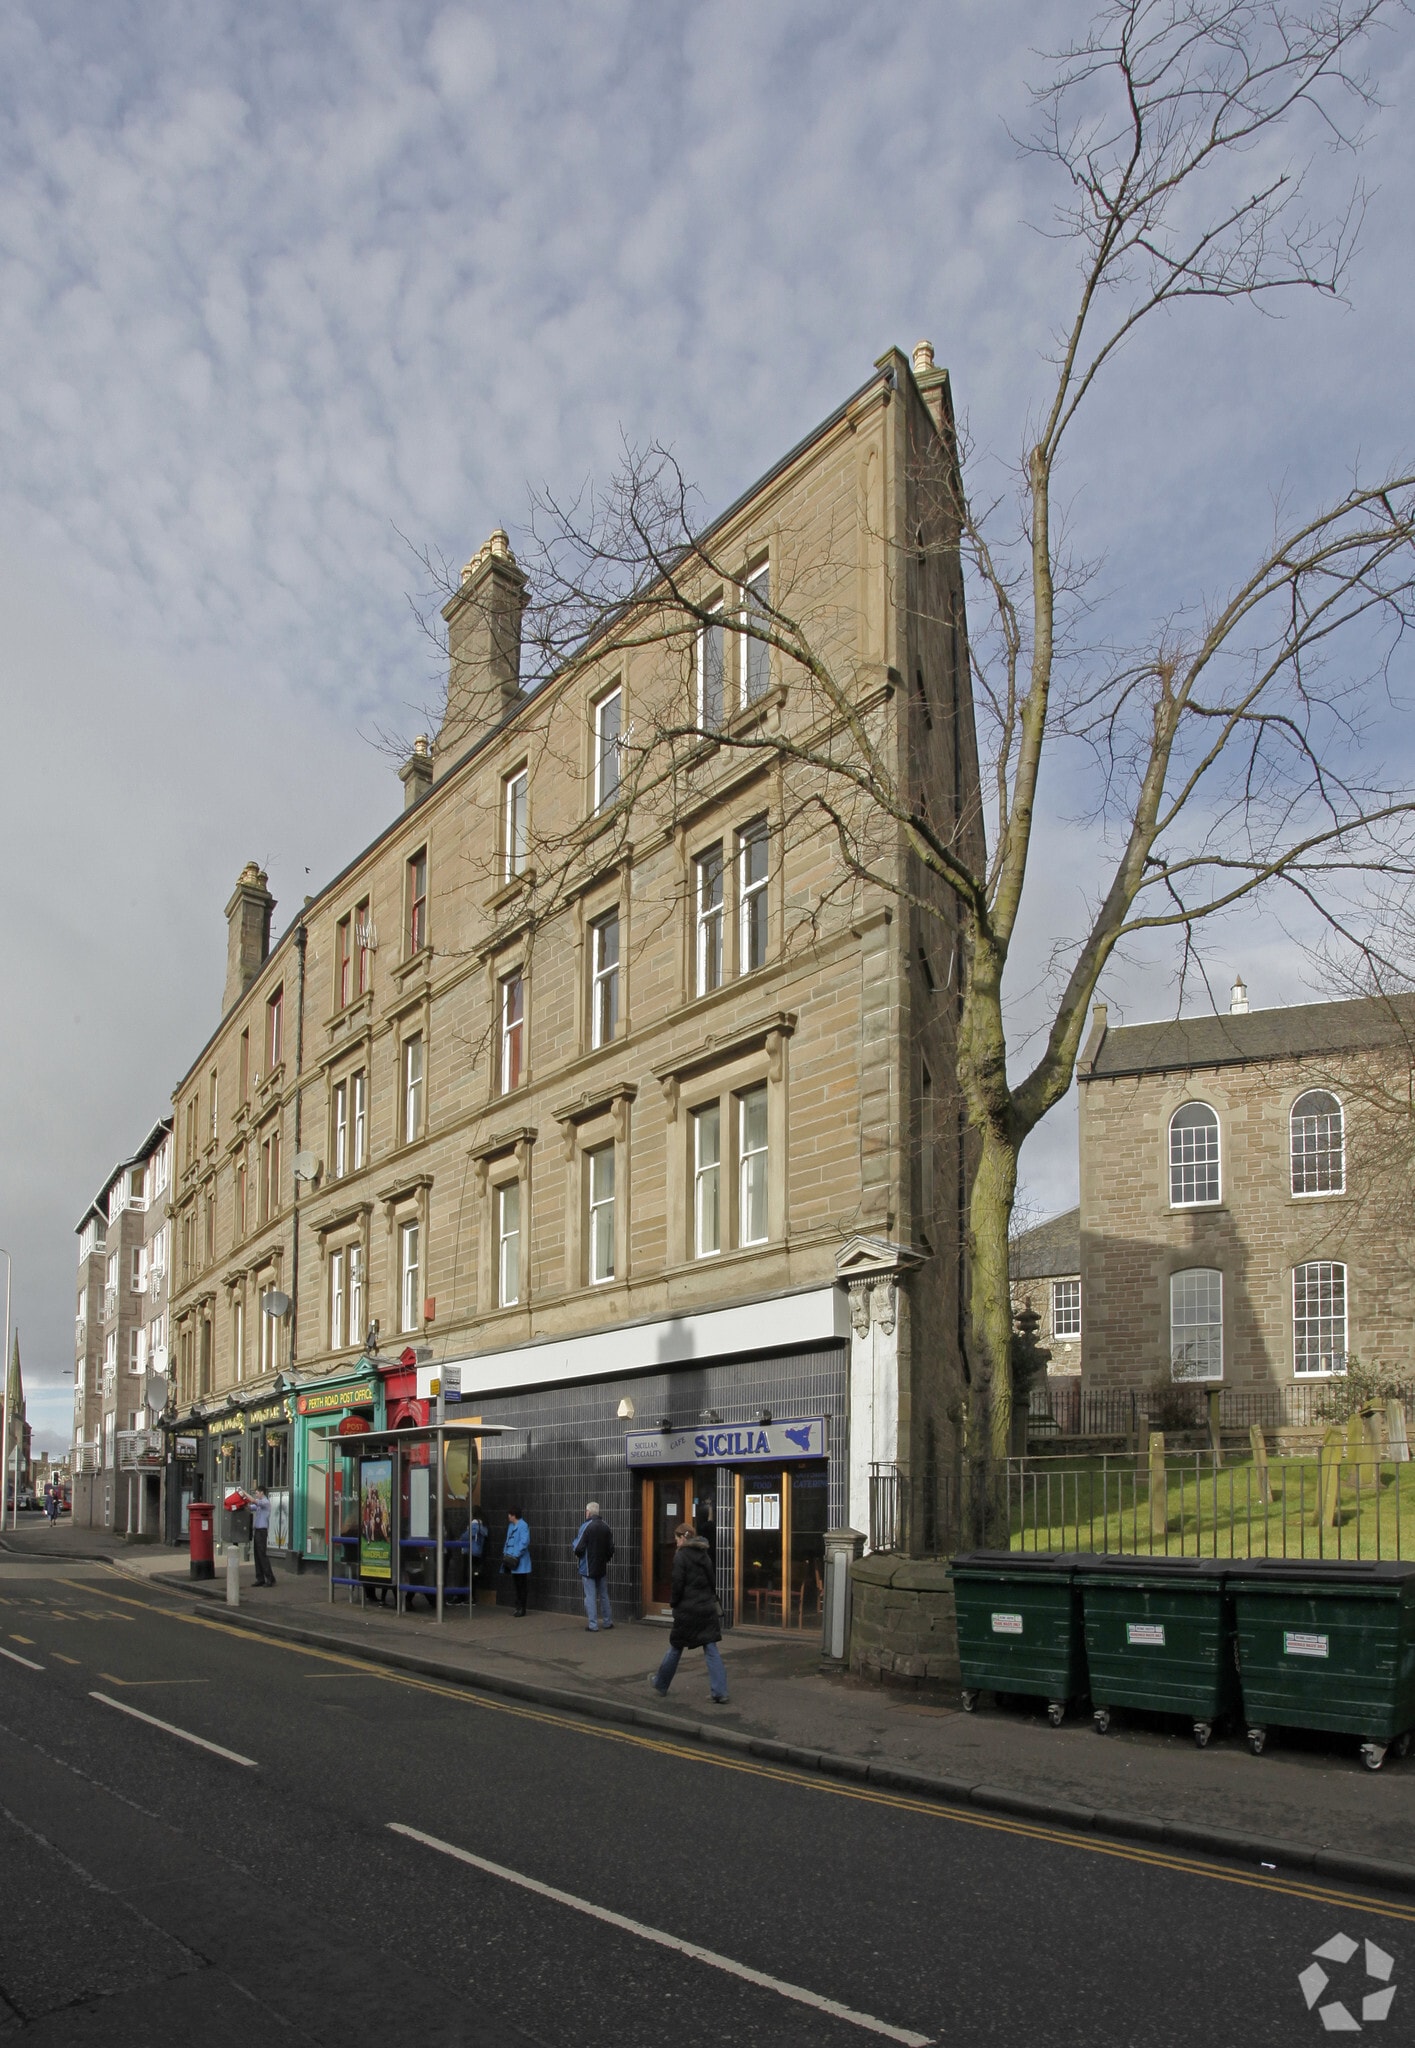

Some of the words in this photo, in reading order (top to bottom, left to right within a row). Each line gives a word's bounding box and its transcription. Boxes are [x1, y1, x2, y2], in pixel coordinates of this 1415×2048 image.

[308, 1397, 324, 1409] PERTH
[324, 1395, 338, 1406] ROAD
[340, 1391, 353, 1404] POST
[346, 1423, 363, 1431] POST
[634, 1441, 658, 1450] SICILIAN
[669, 1436, 687, 1450] CAFE
[694, 1431, 770, 1457] SICILIA
[630, 1449, 662, 1458] SPECIALITY
